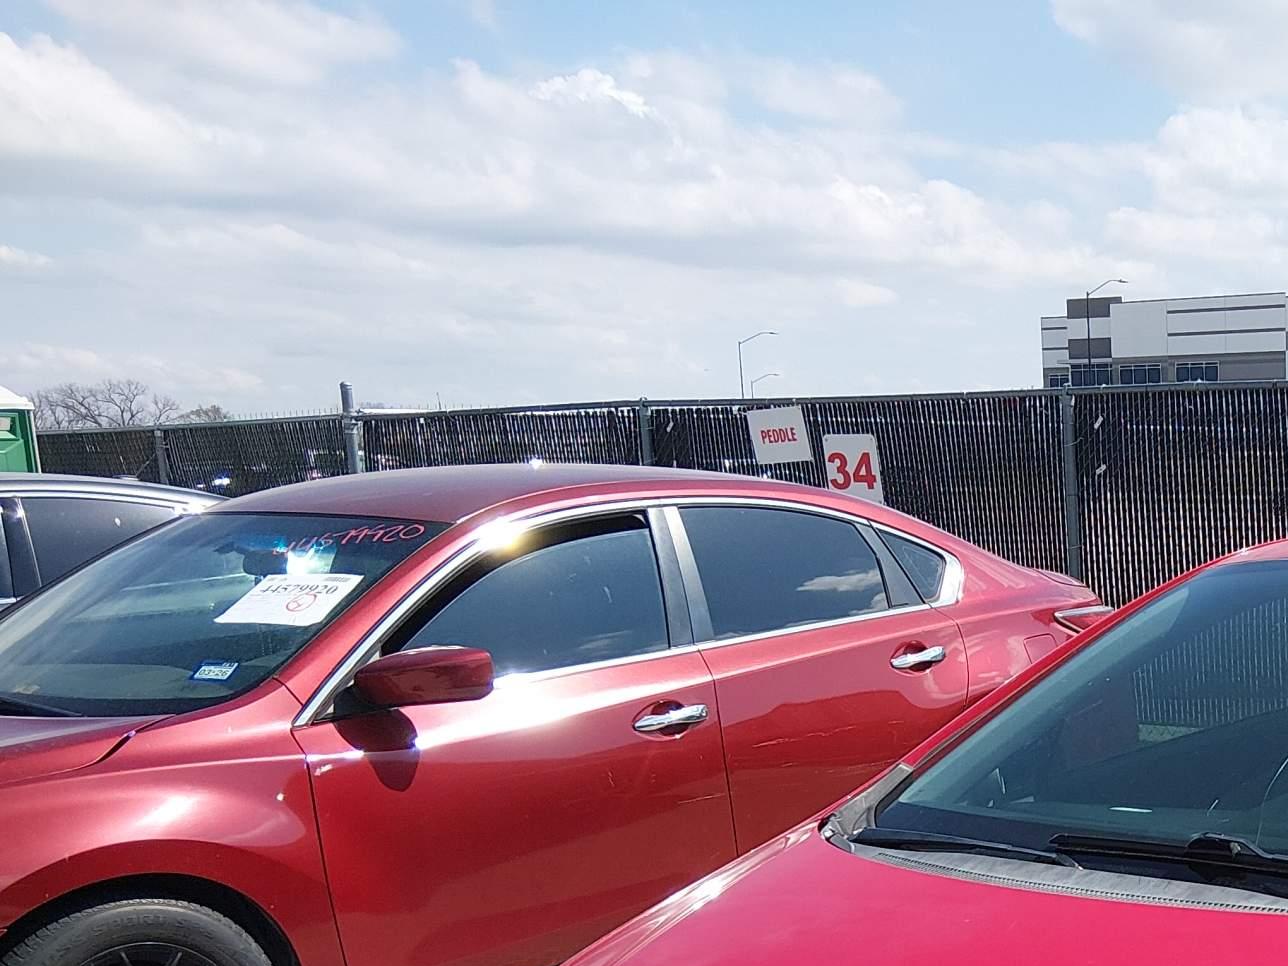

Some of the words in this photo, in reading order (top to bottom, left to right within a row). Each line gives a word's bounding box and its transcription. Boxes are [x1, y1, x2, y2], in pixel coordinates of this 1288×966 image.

[760, 427, 798, 444] PEDDLE
[827, 451, 877, 490] 34
[260, 584, 339, 595] 44579920
